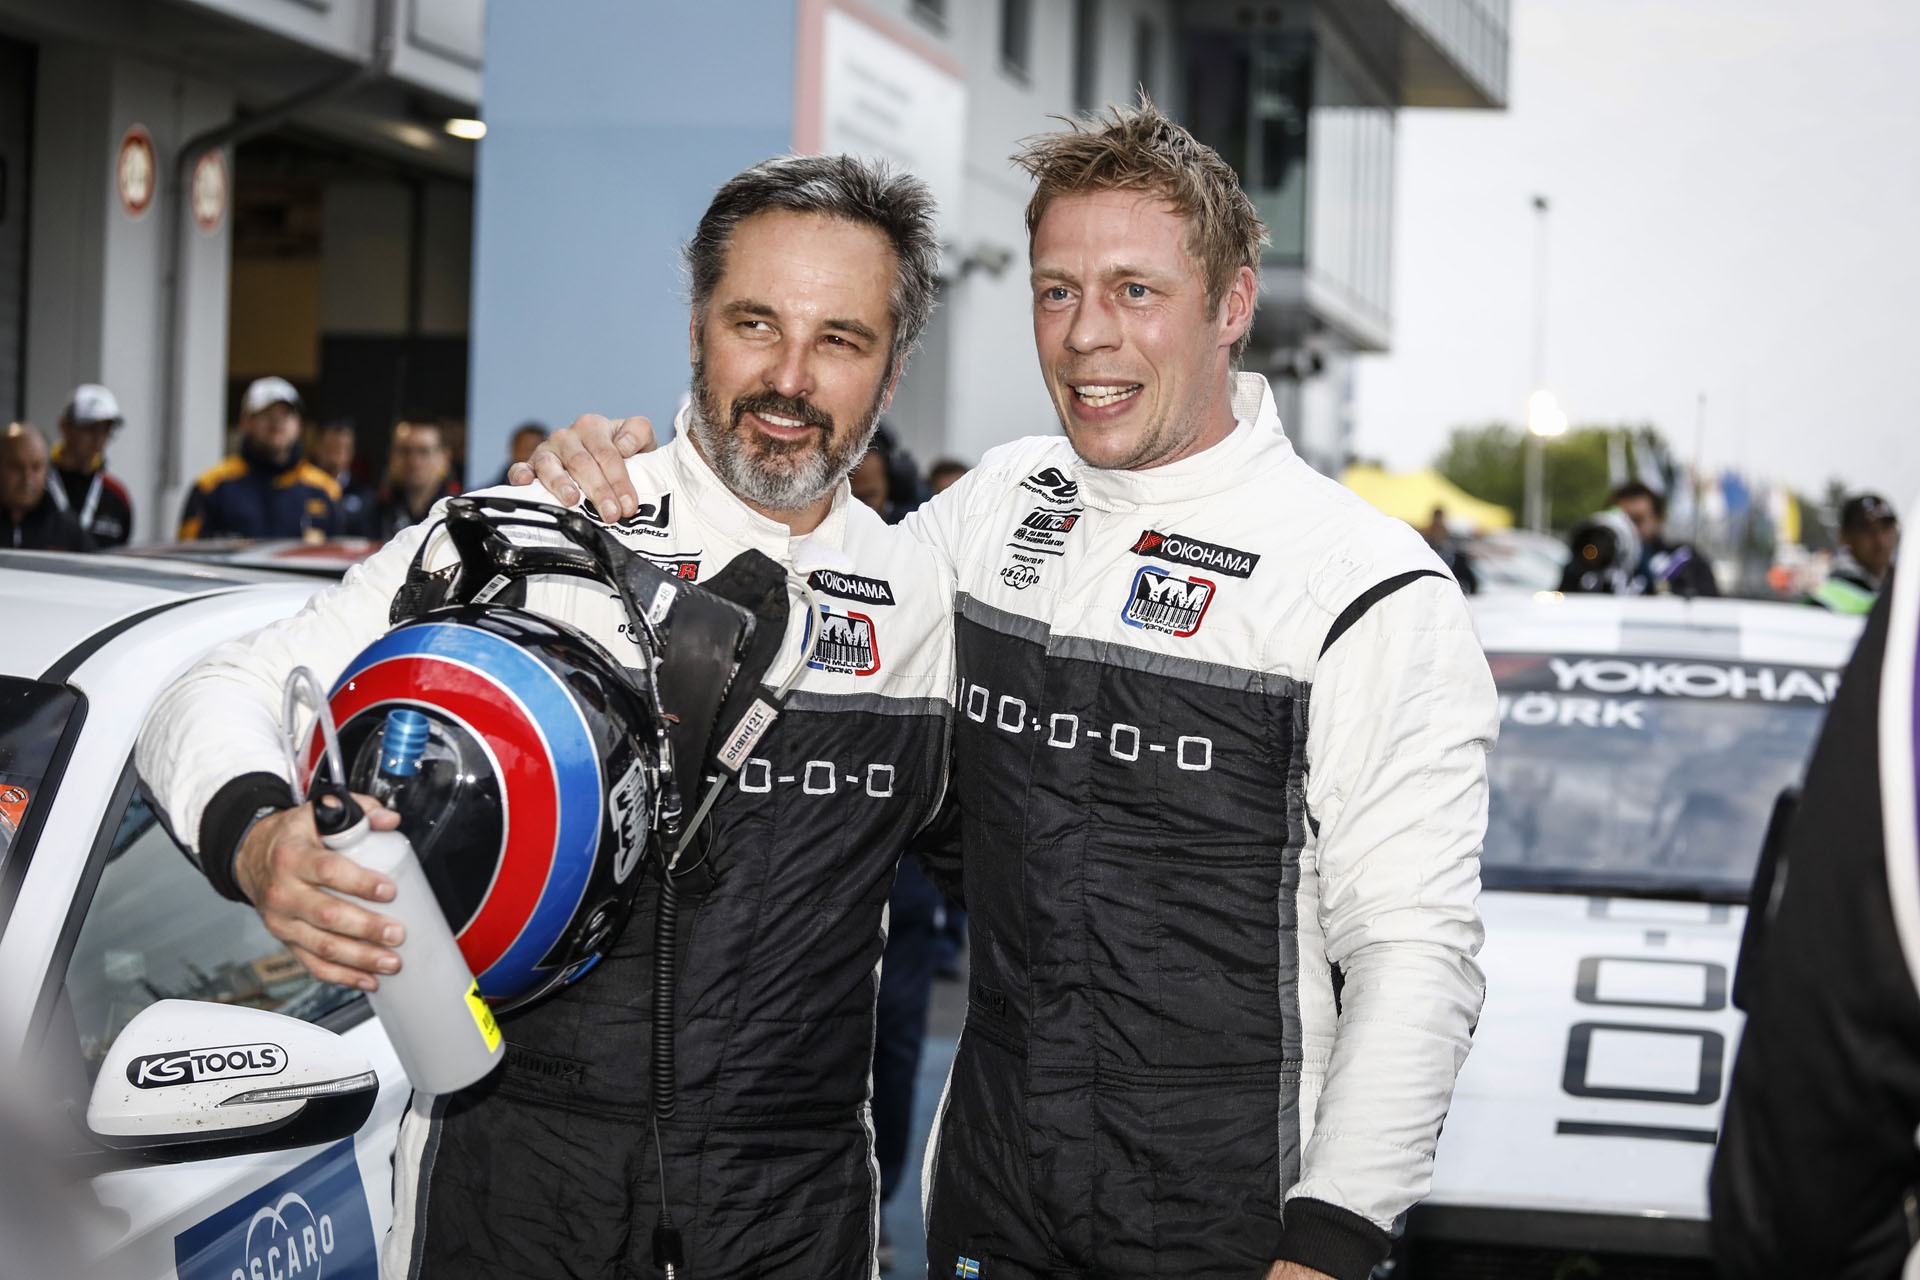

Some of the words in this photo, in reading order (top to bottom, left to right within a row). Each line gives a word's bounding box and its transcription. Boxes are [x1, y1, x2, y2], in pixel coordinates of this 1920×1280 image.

[1159, 538, 1251, 573] YOKOHAMA
[815, 570, 890, 600] YOKOHAMA
[1000, 567, 1040, 584] OSCARO
[727, 712, 764, 760] stand21
[190, 1048, 277, 1075] TOOLS
